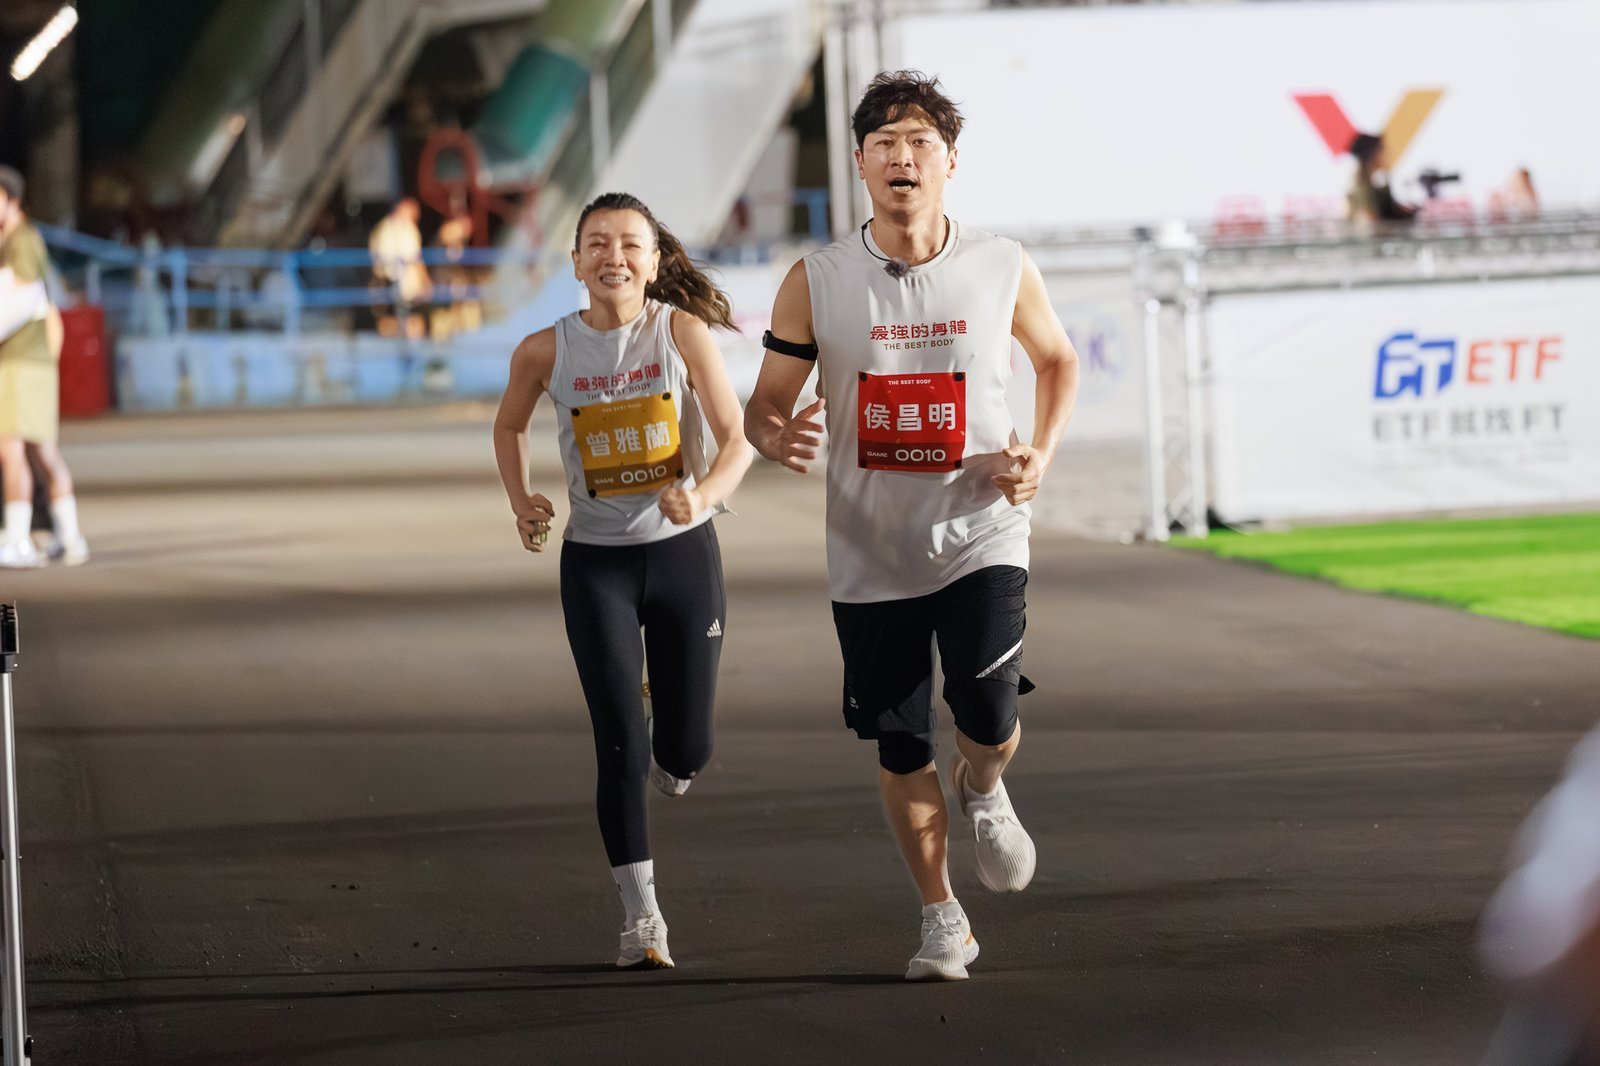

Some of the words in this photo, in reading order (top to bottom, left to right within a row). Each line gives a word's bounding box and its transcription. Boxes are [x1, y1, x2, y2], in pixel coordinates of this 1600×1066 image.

[870, 319, 967, 340] 最強的身體
[904, 341, 927, 349] BEST
[931, 338, 955, 348] BODY
[1466, 335, 1563, 384] ETF
[864, 402, 956, 431] 侯昌明
[586, 421, 670, 458] 曾雅蘭
[895, 449, 946, 462] 0010
[621, 465, 667, 484] 0010
